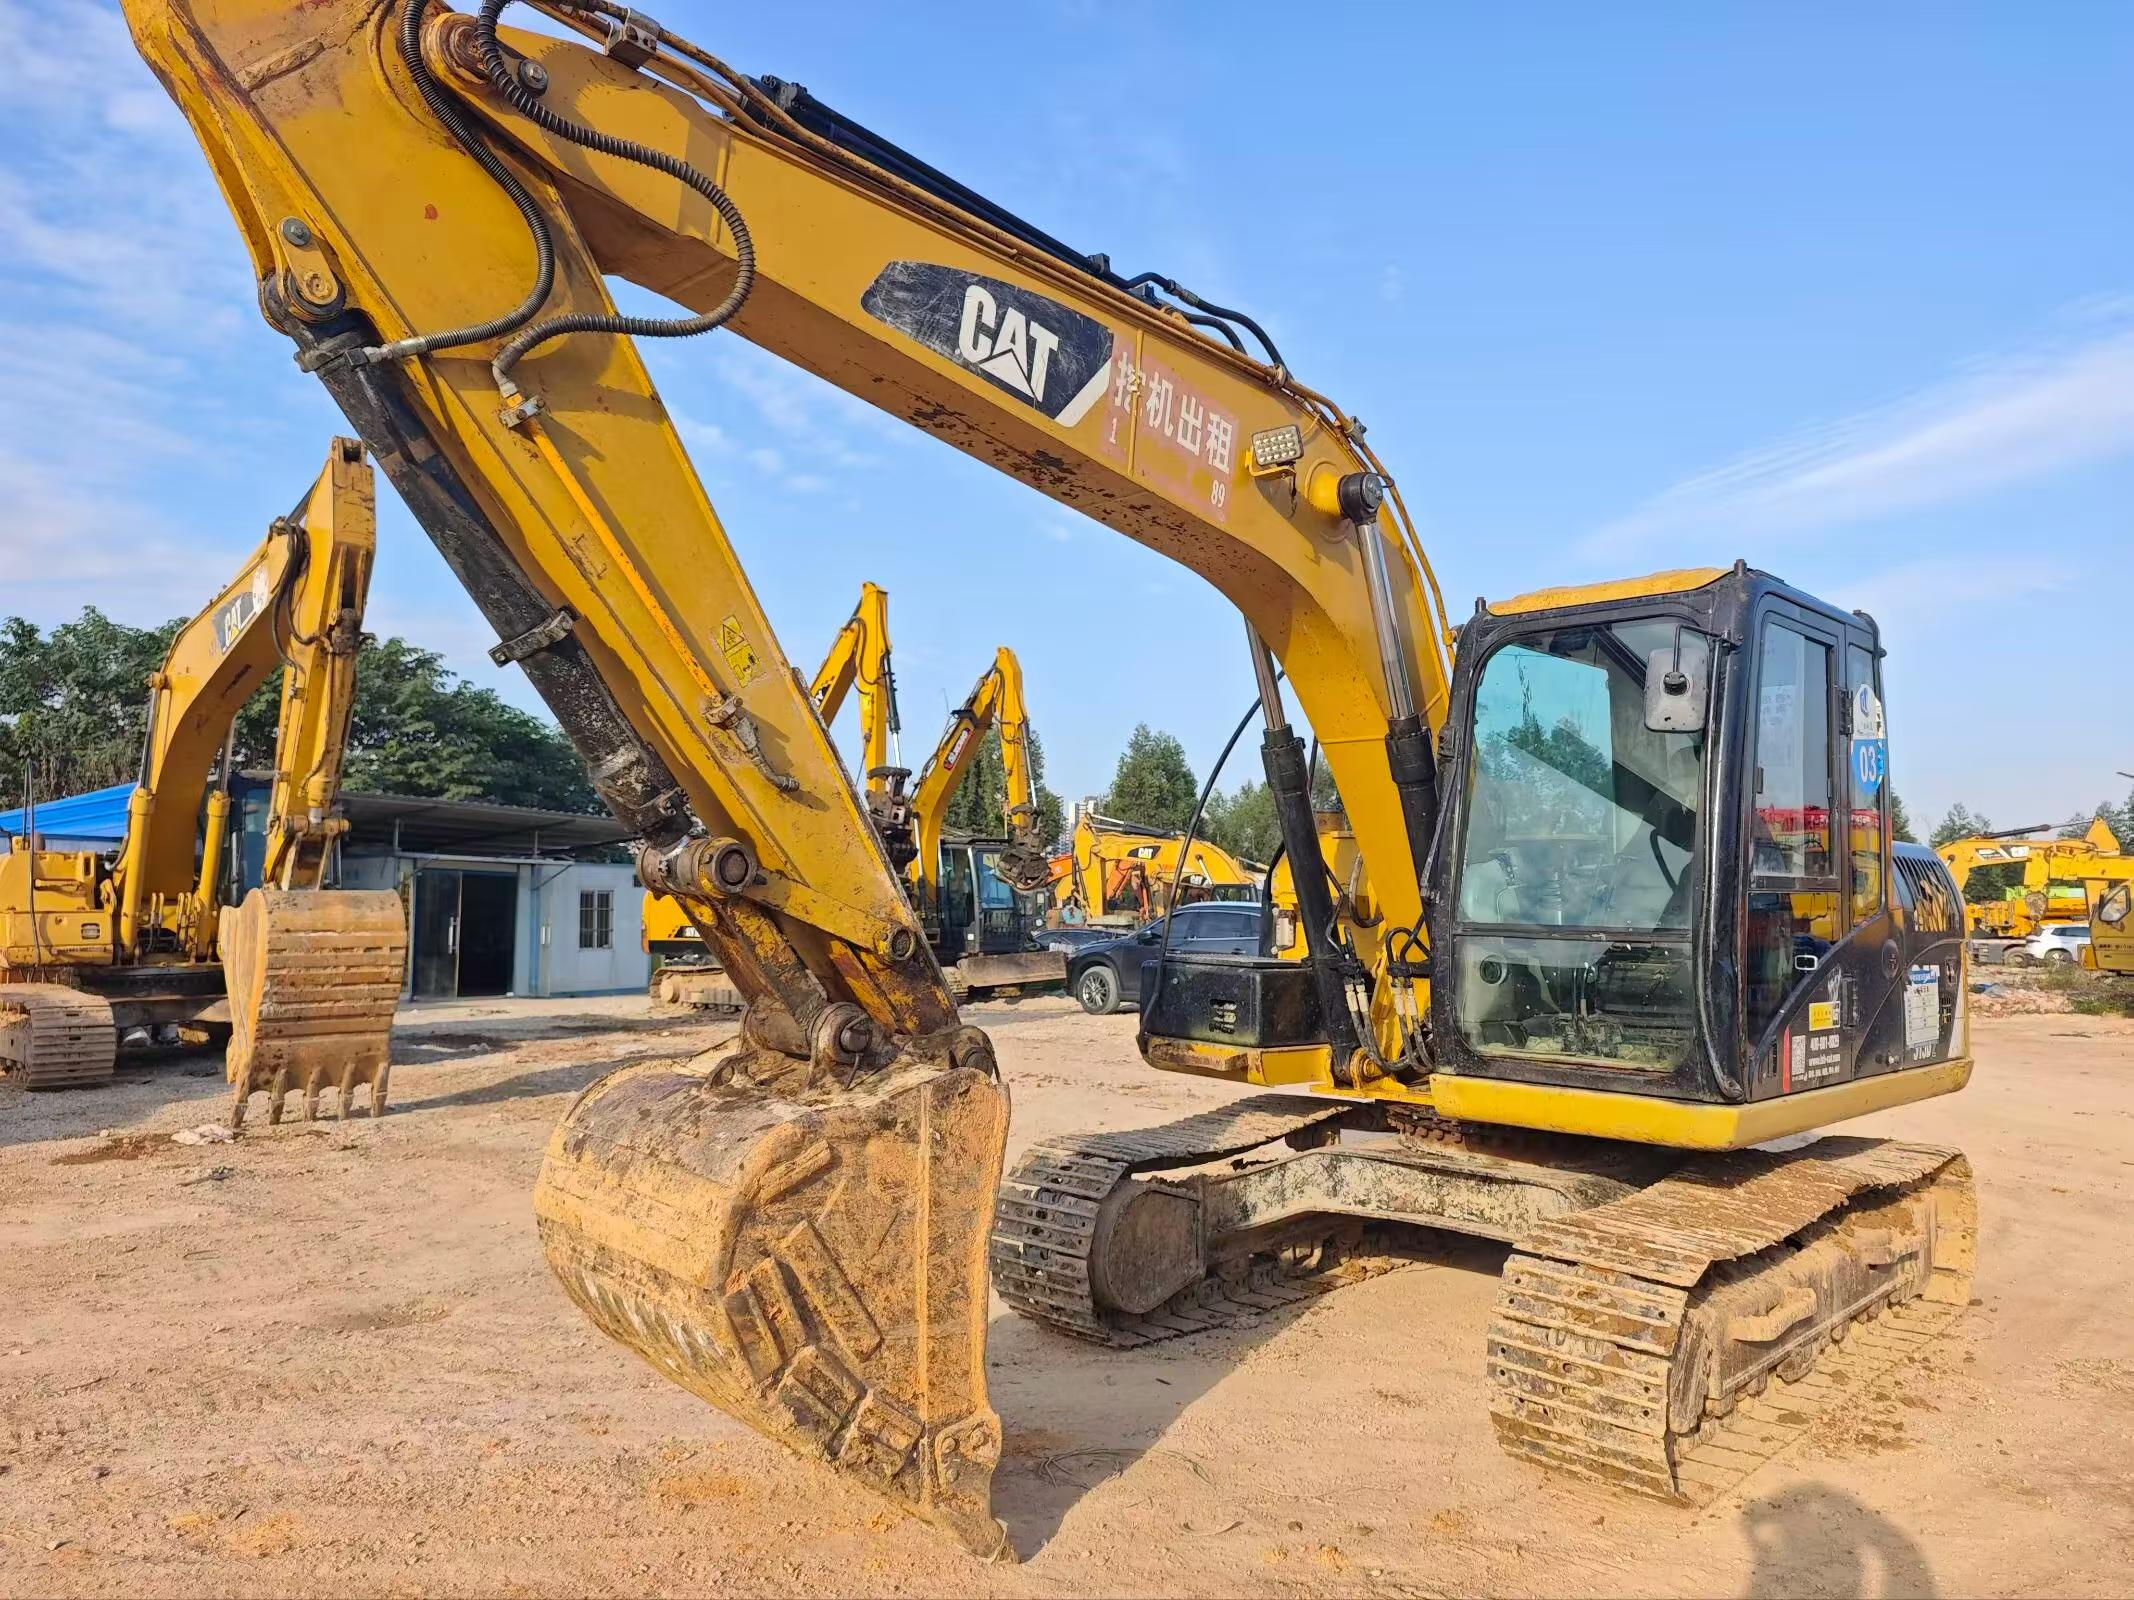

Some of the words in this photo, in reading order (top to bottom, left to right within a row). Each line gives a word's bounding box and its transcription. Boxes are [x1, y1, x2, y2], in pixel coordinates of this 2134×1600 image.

[958, 284, 1059, 403] CAT
[1210, 480, 1226, 508] 89
[225, 596, 242, 647] CAT
[1859, 745, 1877, 784] 03
[1137, 847, 1154, 860] CAT
